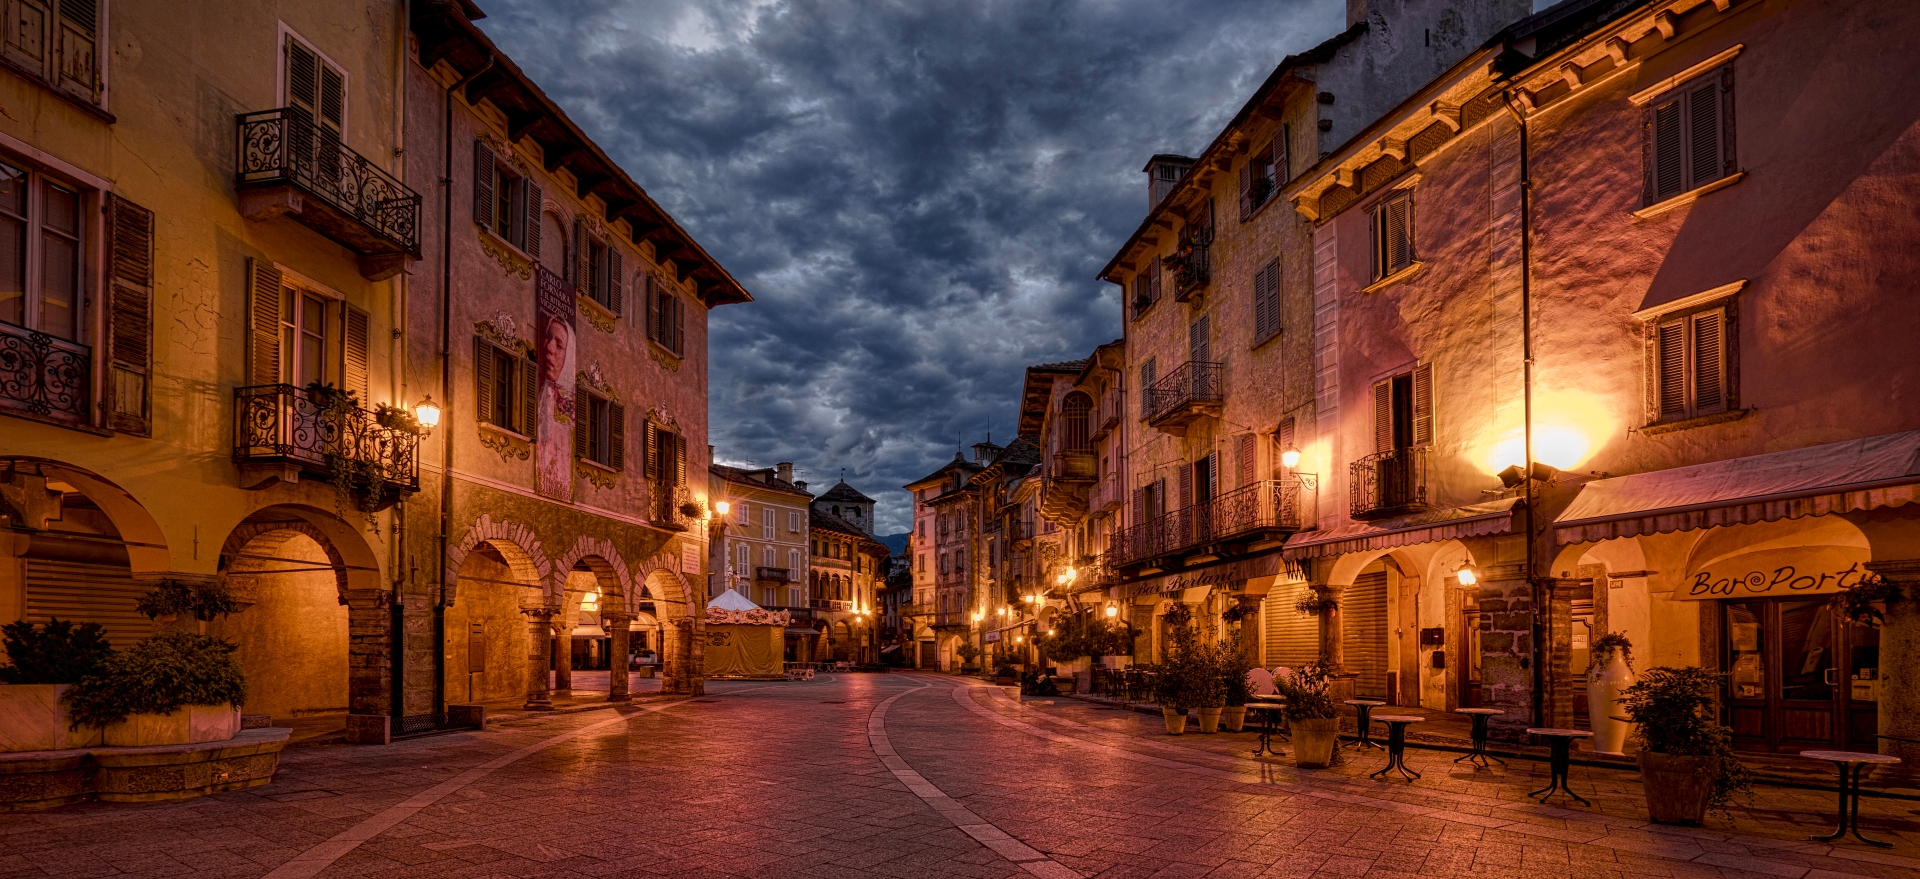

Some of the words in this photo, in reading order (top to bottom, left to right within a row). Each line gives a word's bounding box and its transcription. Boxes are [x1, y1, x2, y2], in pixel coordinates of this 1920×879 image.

[540, 269, 562, 290] CARLO
[540, 278, 571, 306] FORNARA
[540, 288, 544, 297] E
[544, 291, 550, 300] IL
[550, 295, 574, 316] RITRATTO
[1133, 582, 1162, 596] Bar
[1167, 566, 1237, 590] Bertani
[1689, 572, 1745, 596] Bar
